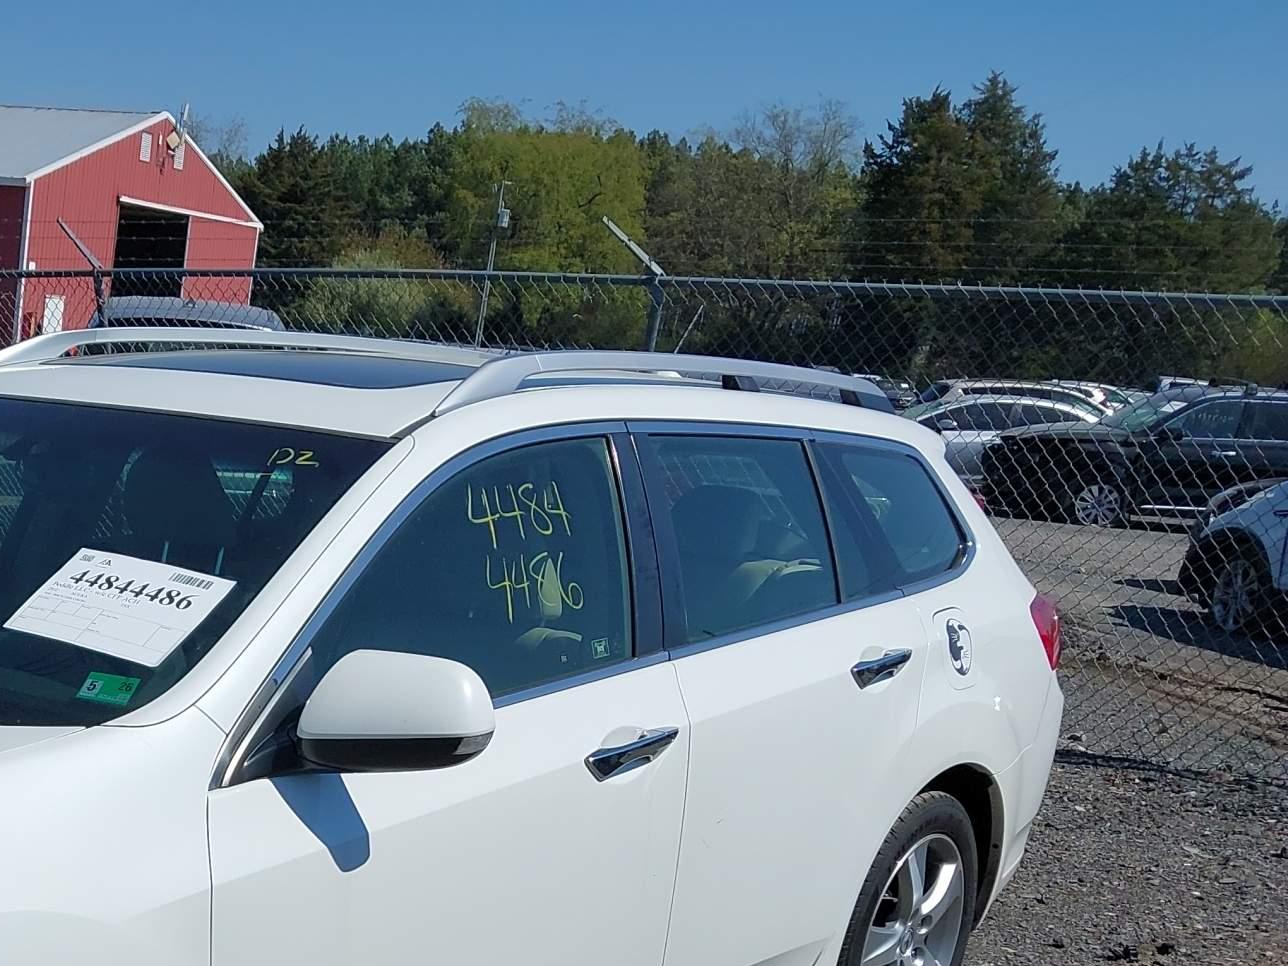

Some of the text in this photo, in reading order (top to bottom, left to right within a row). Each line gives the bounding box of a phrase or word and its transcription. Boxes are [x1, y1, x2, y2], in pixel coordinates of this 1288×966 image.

[466, 480, 572, 550] 4484
[69, 569, 201, 610] 44844486
[485, 551, 585, 625] 4486
[86, 680, 135, 692] 5 26
